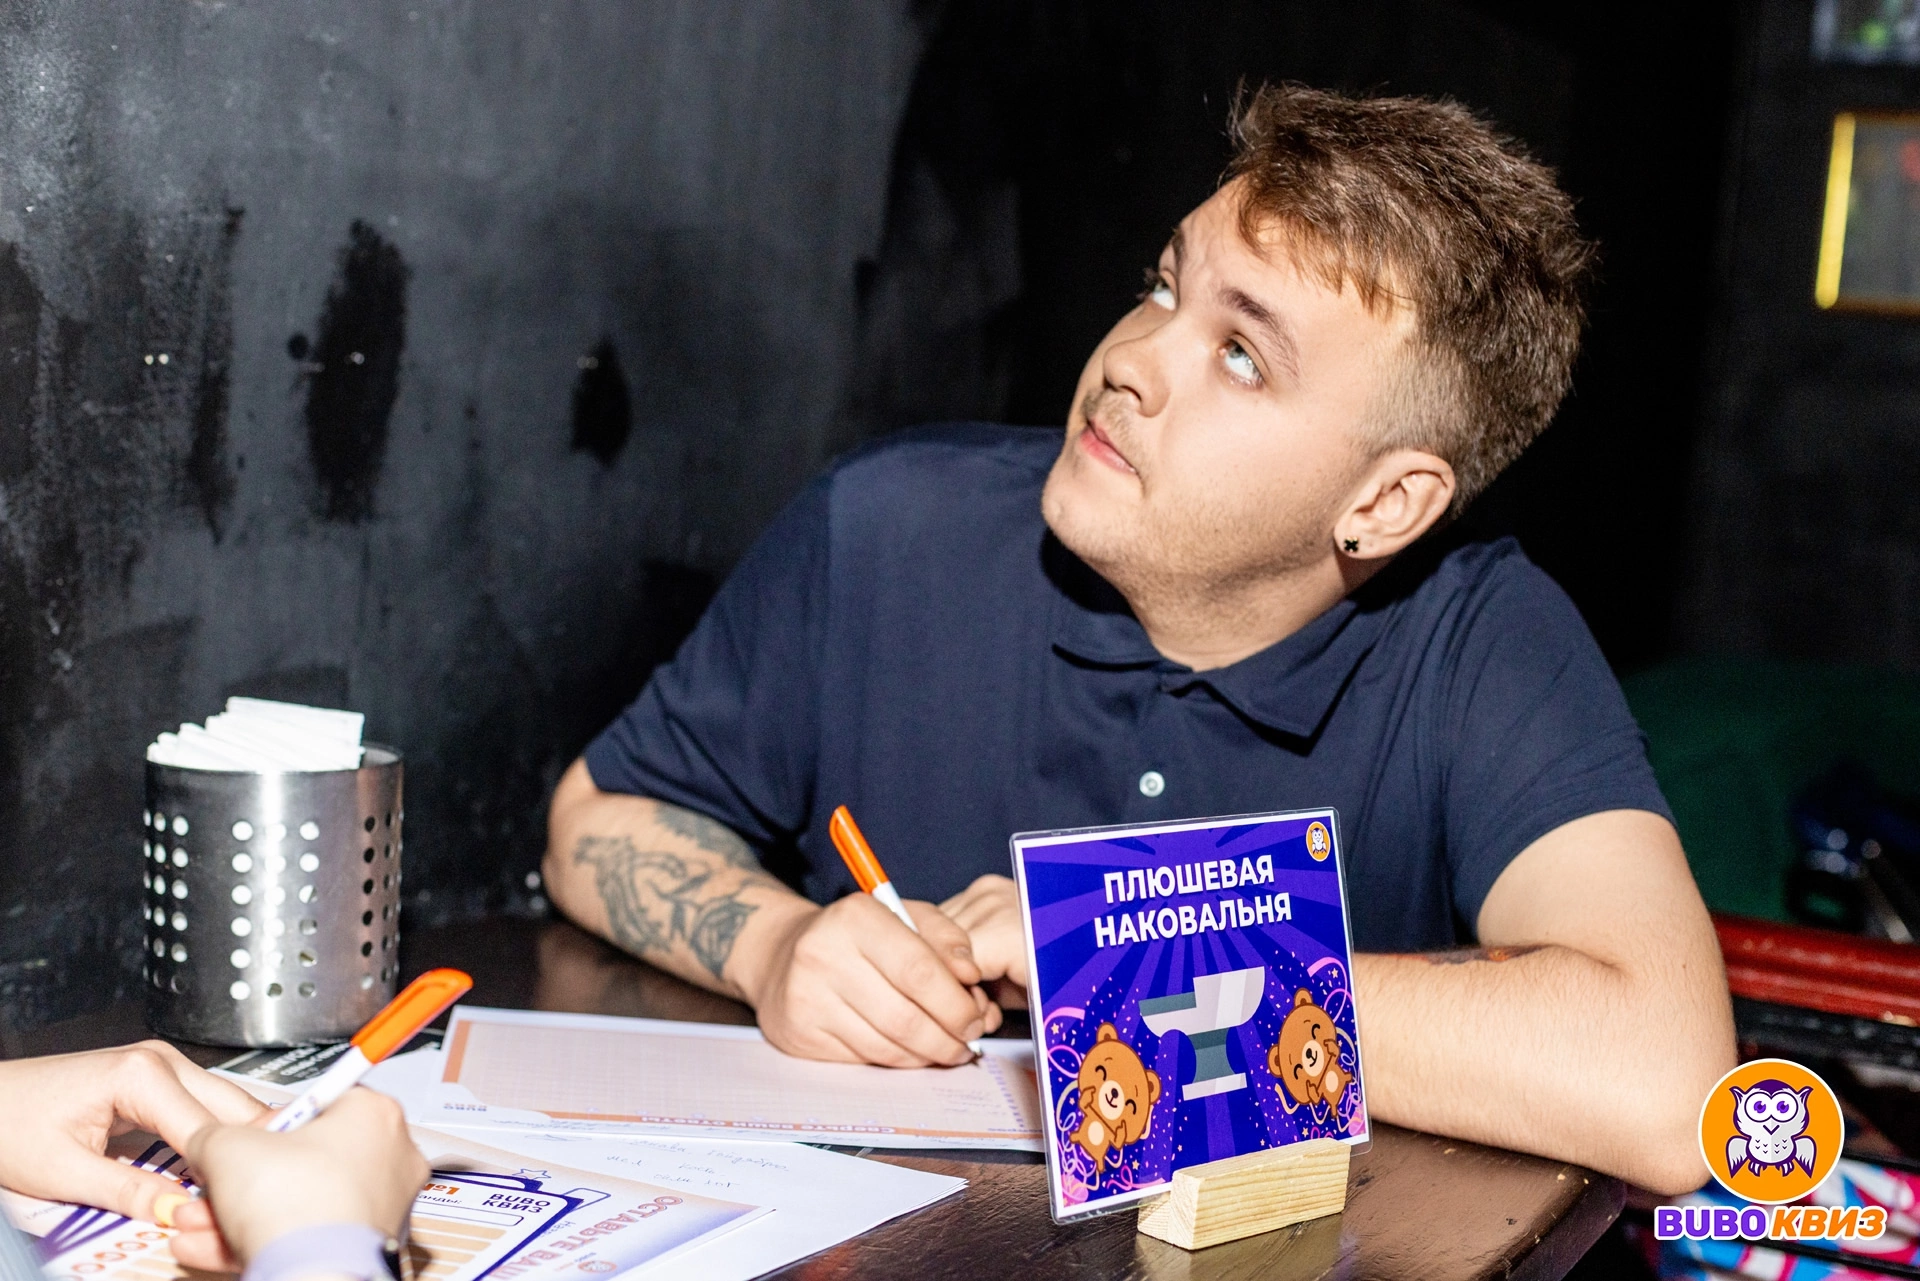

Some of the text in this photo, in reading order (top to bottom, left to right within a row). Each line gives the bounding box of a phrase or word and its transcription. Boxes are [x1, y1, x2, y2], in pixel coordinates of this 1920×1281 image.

[1103, 854, 1275, 904] ПЛЮШЕВАЯ
[1094, 891, 1292, 948] НАКОВАЛЬНЯ
[418, 1194, 463, 1205] анды:
[481, 1199, 545, 1214] КВИЗ
[488, 1193, 552, 1208] BUBO
[549, 1195, 684, 1251] ОСТАВЬТЕ
